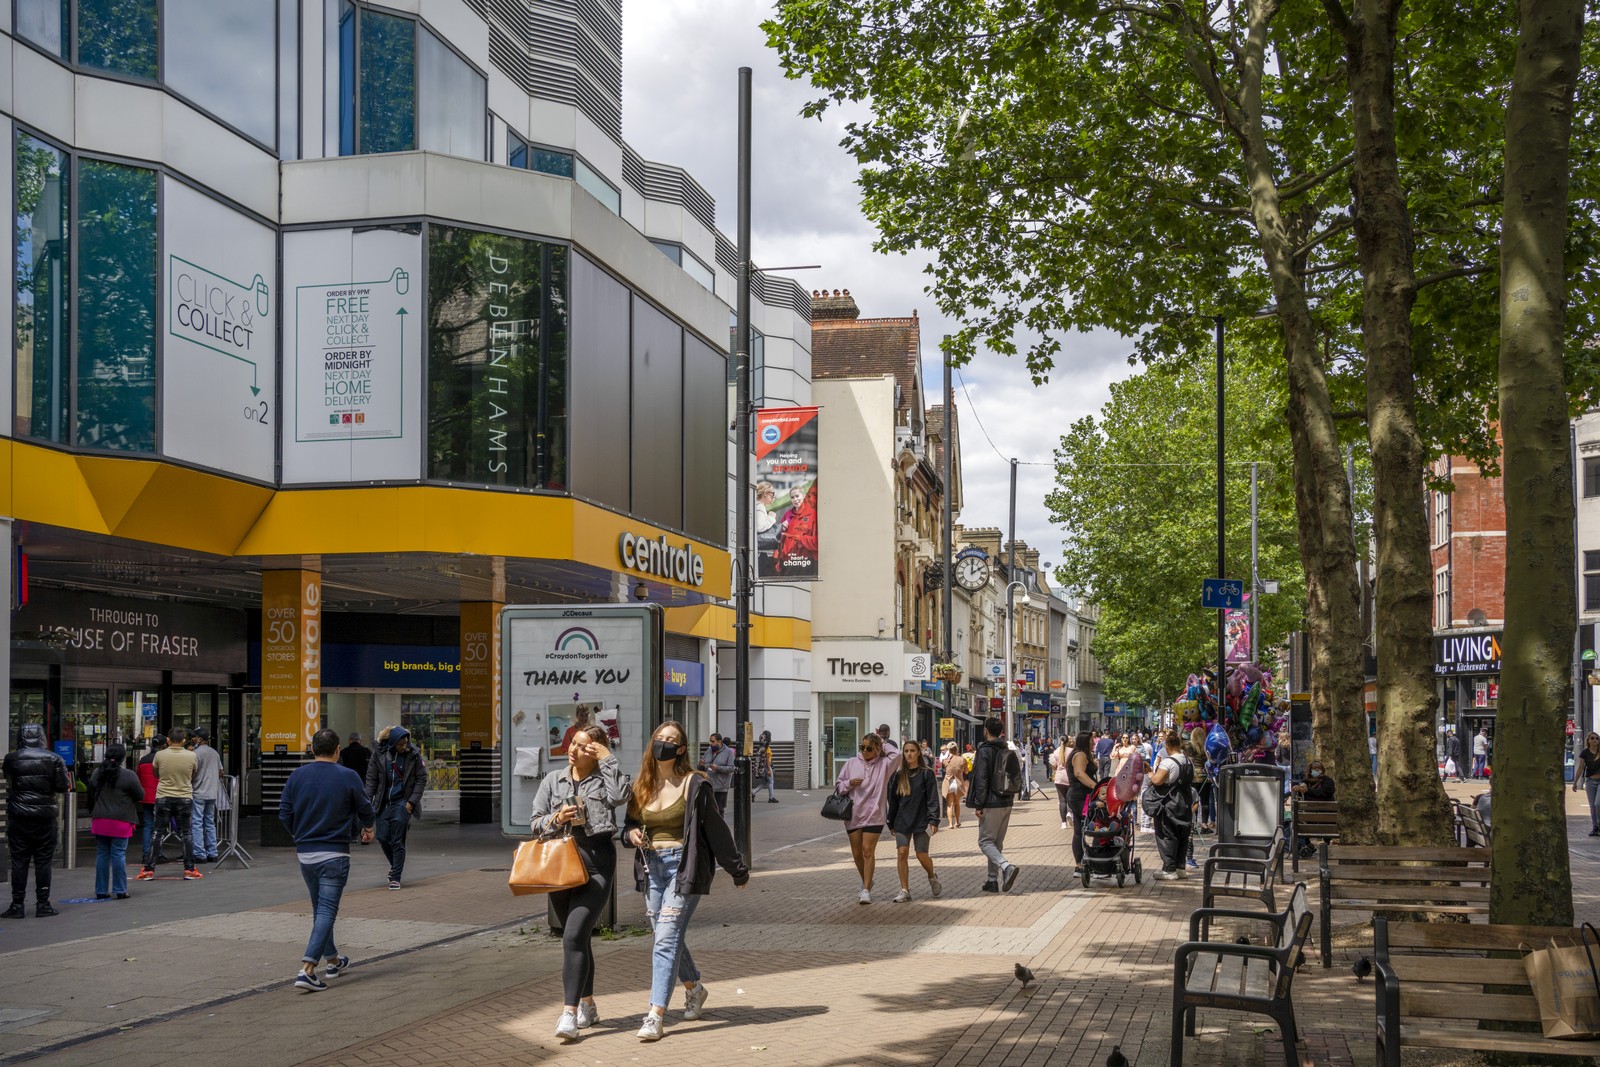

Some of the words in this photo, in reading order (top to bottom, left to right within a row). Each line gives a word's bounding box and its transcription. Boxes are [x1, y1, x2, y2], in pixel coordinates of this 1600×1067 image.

[178, 274, 236, 321] CLICK
[240, 300, 254, 328] &
[326, 296, 370, 314] FREE
[326, 316, 350, 324] NEXT
[351, 314, 370, 323] DAY
[178, 304, 254, 350] COLLECT
[326, 324, 358, 336] CLICK
[361, 323, 369, 334] &
[326, 334, 370, 346] COLLECT
[325, 352, 358, 361] ORDER
[360, 350, 372, 359] BY
[488, 255, 508, 473] DEBENHAMS
[325, 371, 350, 380] NEXT
[352, 370, 372, 380] DAY
[324, 380, 372, 396] HOME
[324, 395, 372, 406] DELIVERY
[772, 464, 808, 472] around
[619, 531, 704, 586] centrale
[90, 608, 143, 626] THROUGH
[145, 613, 159, 628] TO
[268, 608, 296, 619] OVER
[267, 620, 296, 644] 50
[464, 632, 488, 642] OVER
[110, 630, 135, 652] OF
[141, 633, 198, 656] FRASER
[267, 652, 296, 661] STORES
[464, 643, 488, 661] 50
[303, 582, 319, 743] centrale
[384, 660, 400, 672] big
[402, 660, 437, 671] brands,
[438, 662, 454, 673] big
[827, 658, 884, 676] Three
[1435, 664, 1448, 674] Rugs
[1456, 662, 1488, 672] Kitchenware
[524, 669, 587, 686] THANK
[595, 668, 630, 685] YOU
[671, 667, 687, 688] buys
[266, 732, 296, 740] centrale
[1558, 968, 1600, 979] PRIMA
